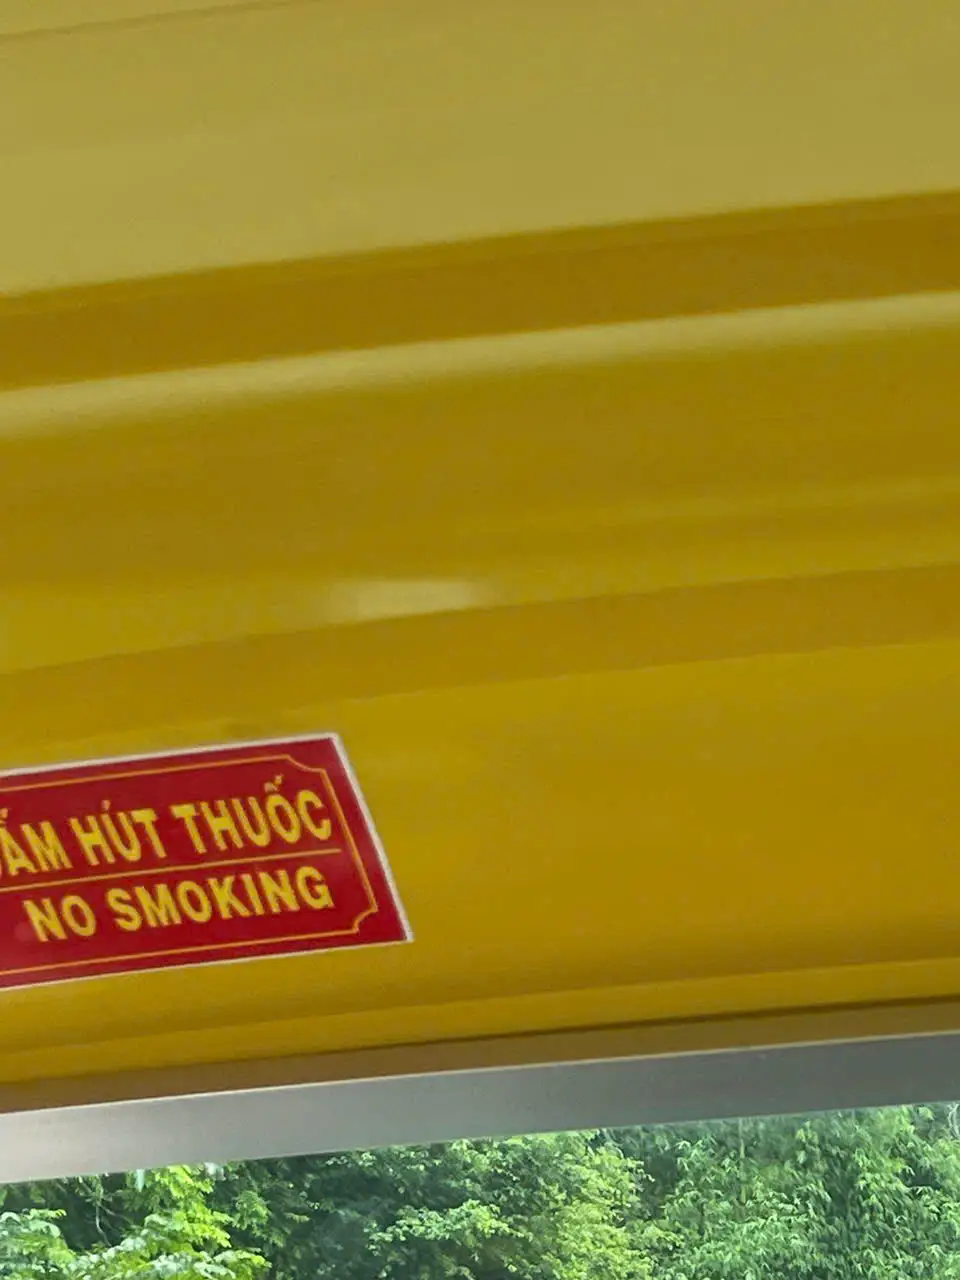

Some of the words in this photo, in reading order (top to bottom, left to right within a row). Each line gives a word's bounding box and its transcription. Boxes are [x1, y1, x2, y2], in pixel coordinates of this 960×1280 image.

[0, 807, 73, 877] ẤM
[71, 800, 167, 867] HÚT
[172, 774, 333, 855] THUỐC
[23, 895, 97, 943] NO
[105, 866, 334, 932] SMOKING
